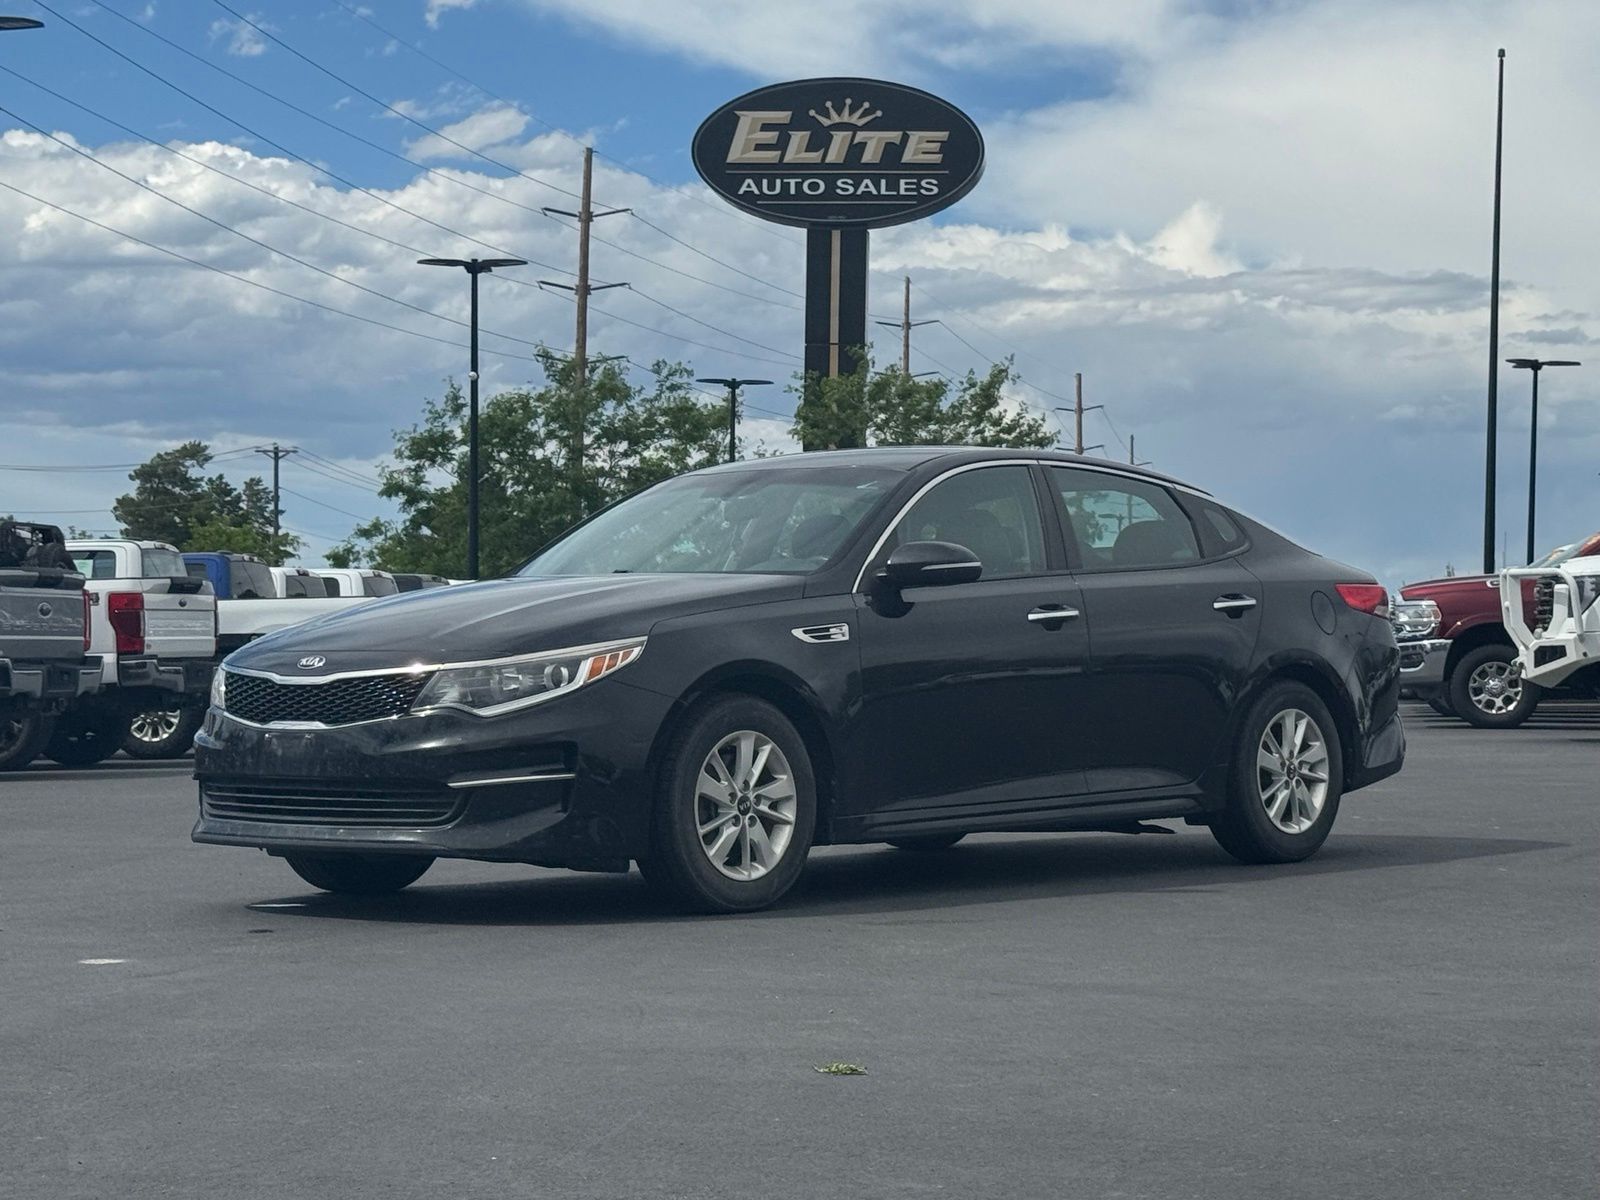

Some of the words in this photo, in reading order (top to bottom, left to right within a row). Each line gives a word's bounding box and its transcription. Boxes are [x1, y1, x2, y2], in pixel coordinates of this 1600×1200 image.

[726, 110, 949, 163] ELITE
[738, 178, 825, 195] AUTO
[835, 178, 939, 195] SALES
[299, 656, 322, 667] KIA
